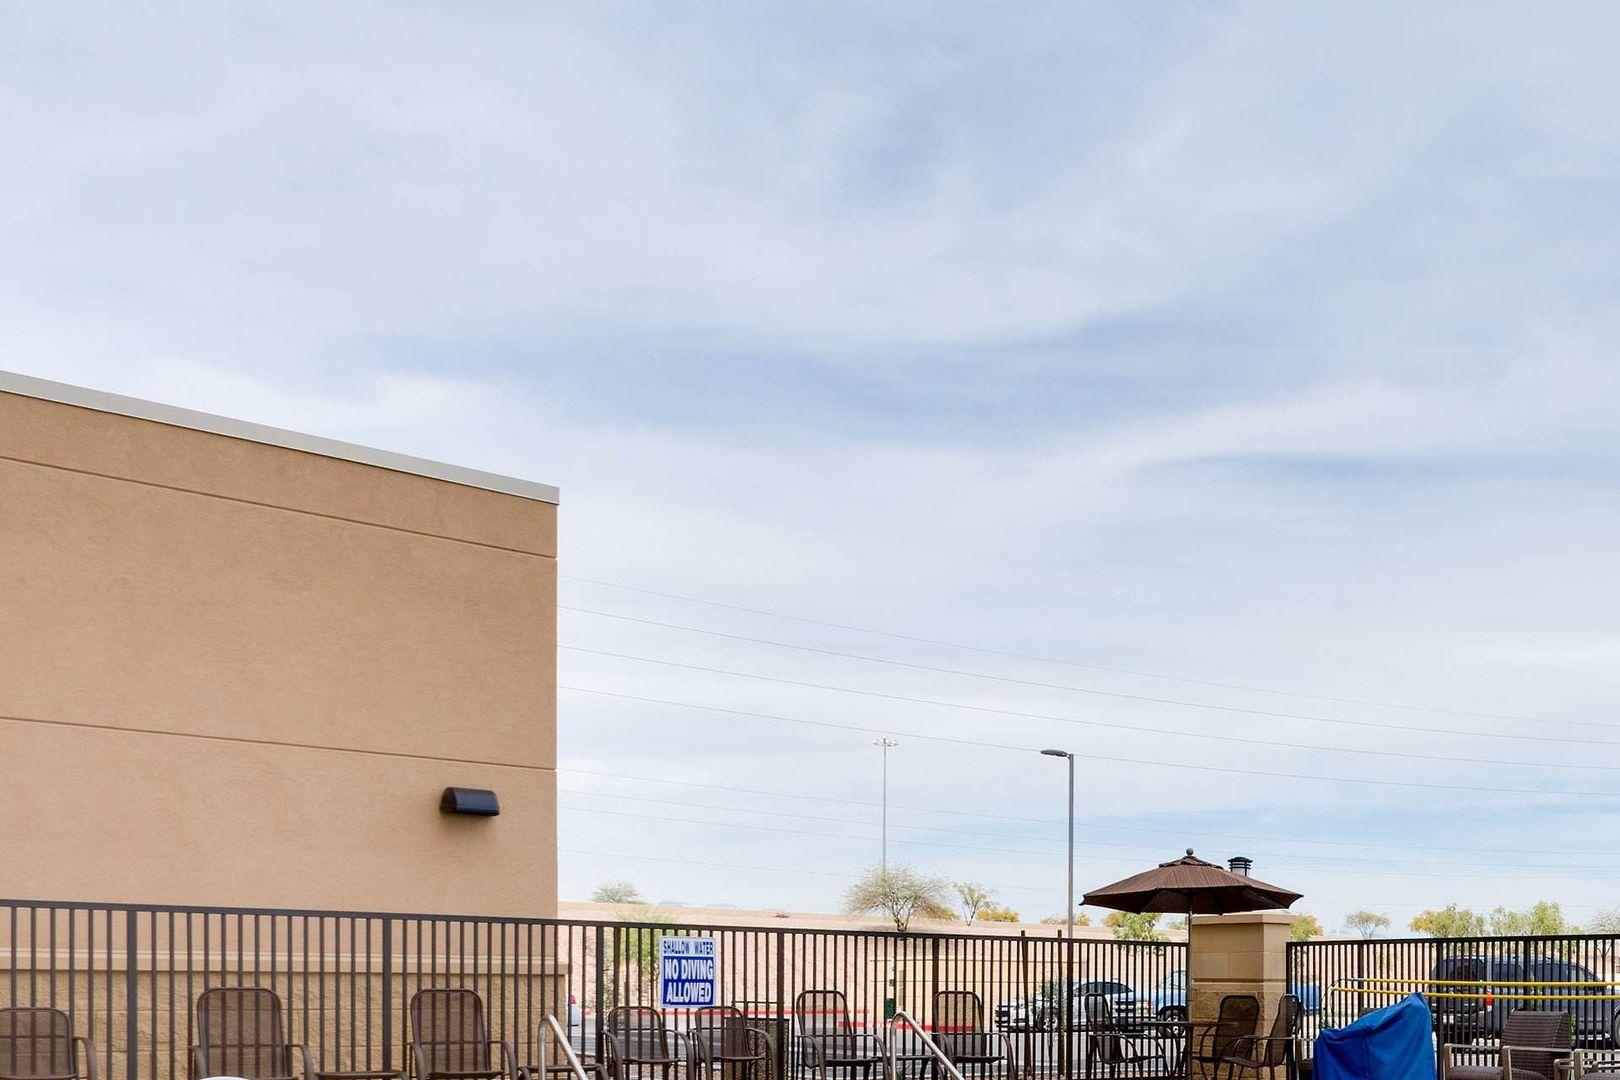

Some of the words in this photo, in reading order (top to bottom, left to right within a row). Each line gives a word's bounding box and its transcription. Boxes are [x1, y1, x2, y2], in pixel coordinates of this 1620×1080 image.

[664, 940, 690, 954] SHALLOW
[694, 941, 713, 955] WATER
[664, 959, 679, 980] NO
[681, 959, 713, 980] DIVING
[666, 982, 712, 1003] ALLOWED
